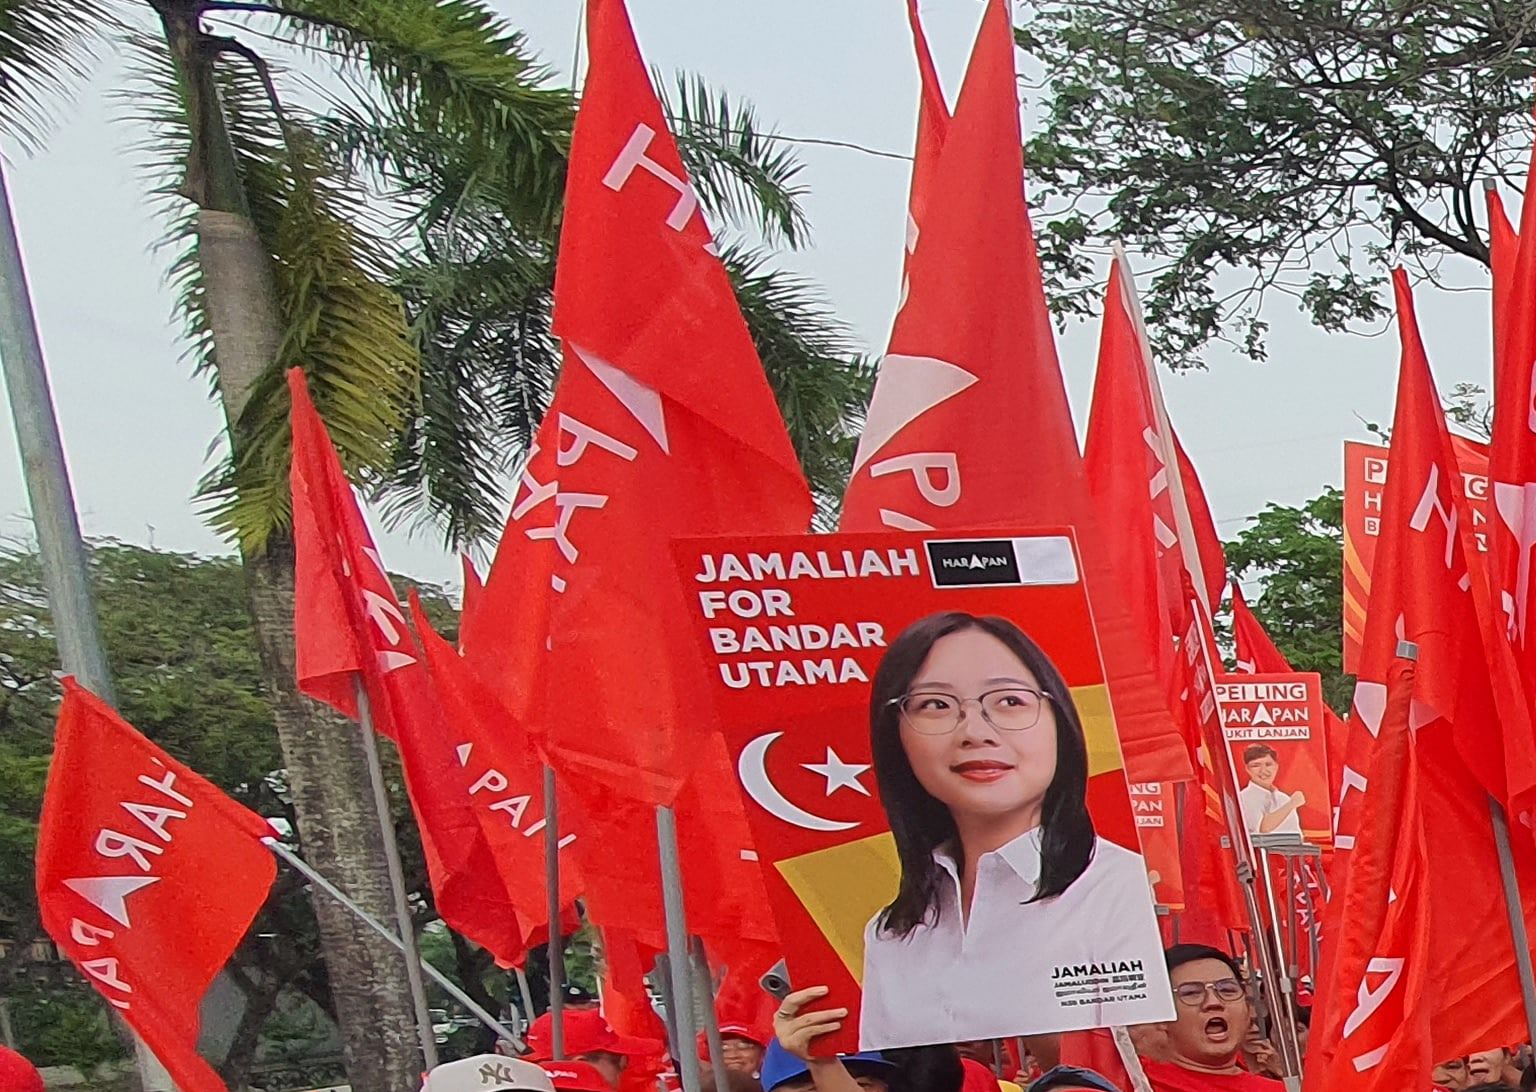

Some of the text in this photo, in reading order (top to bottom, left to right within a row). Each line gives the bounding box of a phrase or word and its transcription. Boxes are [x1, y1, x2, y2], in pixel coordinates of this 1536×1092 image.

[695, 548, 920, 583] JAMALIAH
[942, 553, 1008, 570] HARAPAN
[699, 589, 795, 619] FOR
[708, 622, 888, 655] BANDAR
[719, 658, 869, 688] UTAMA
[1255, 684, 1304, 700] LING
[1257, 728, 1308, 739] LANJAN
[1051, 960, 1143, 979] JAMALIAH
